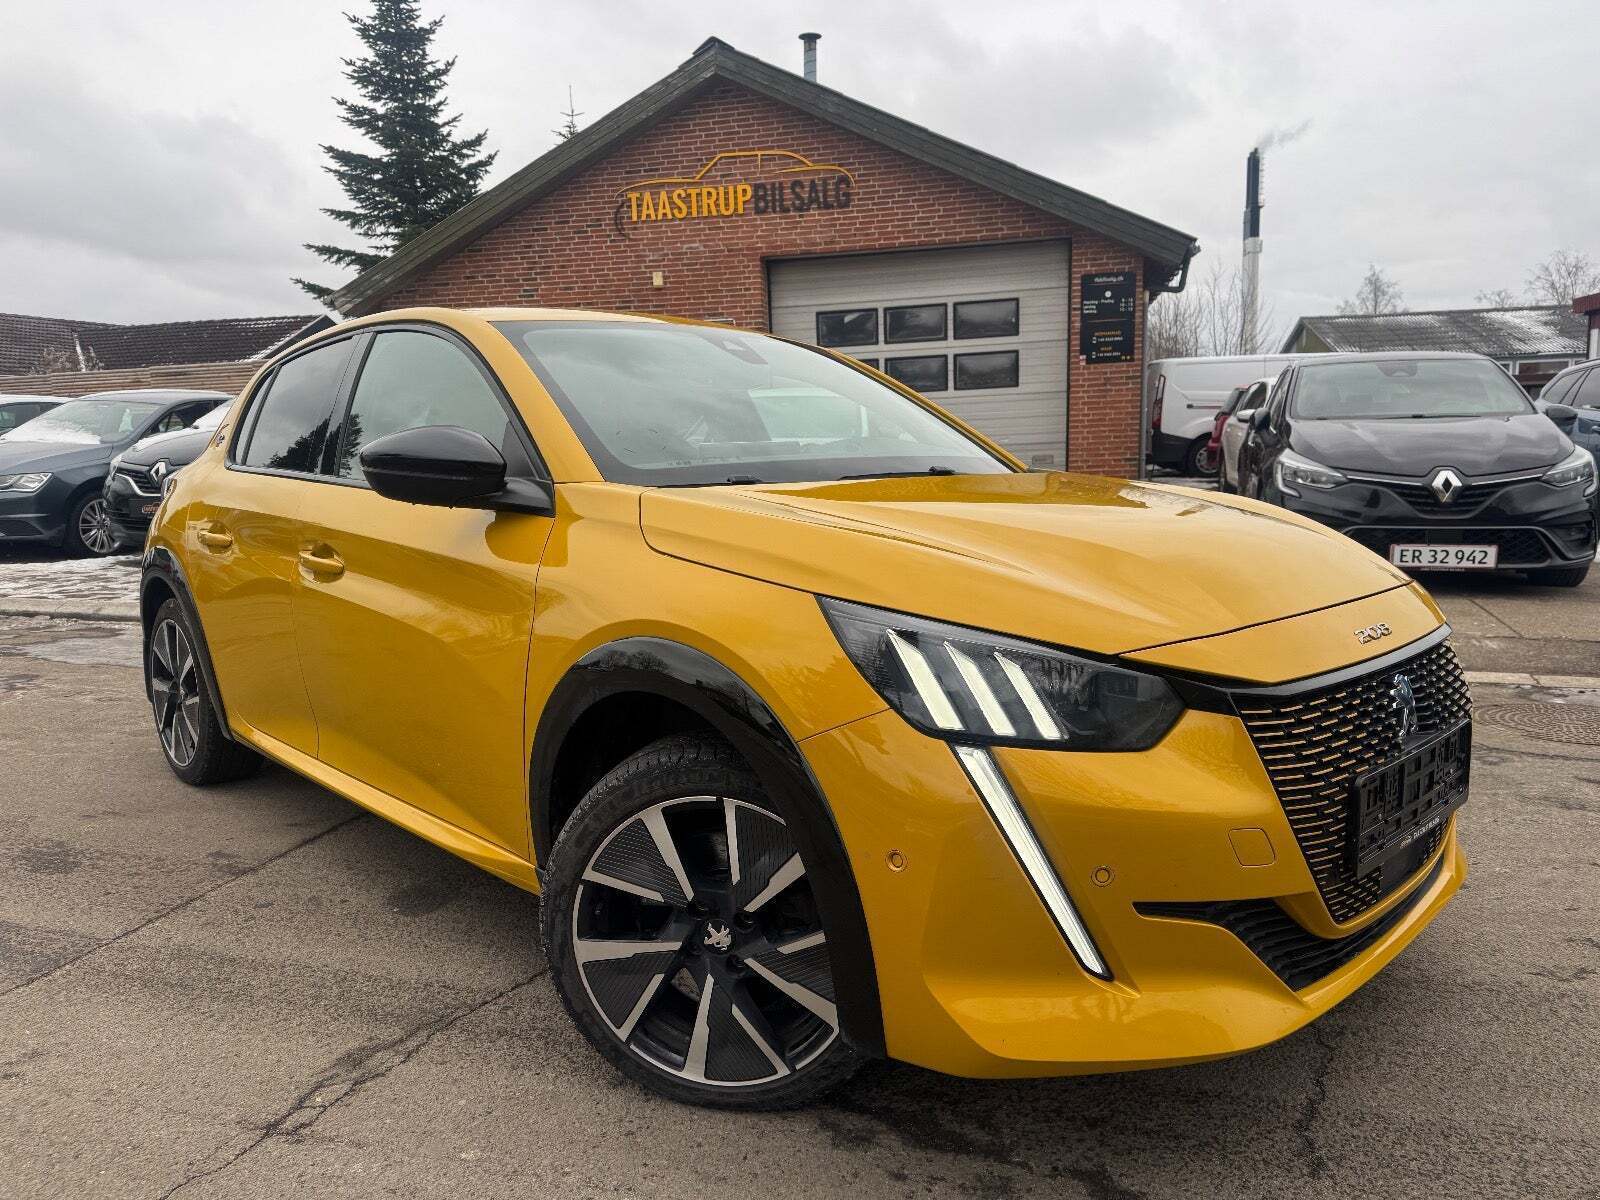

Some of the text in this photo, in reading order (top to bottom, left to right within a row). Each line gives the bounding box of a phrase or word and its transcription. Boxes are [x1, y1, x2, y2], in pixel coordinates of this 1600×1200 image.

[1399, 549, 1488, 565] ER 32 942
[1353, 623, 1392, 644] 208
